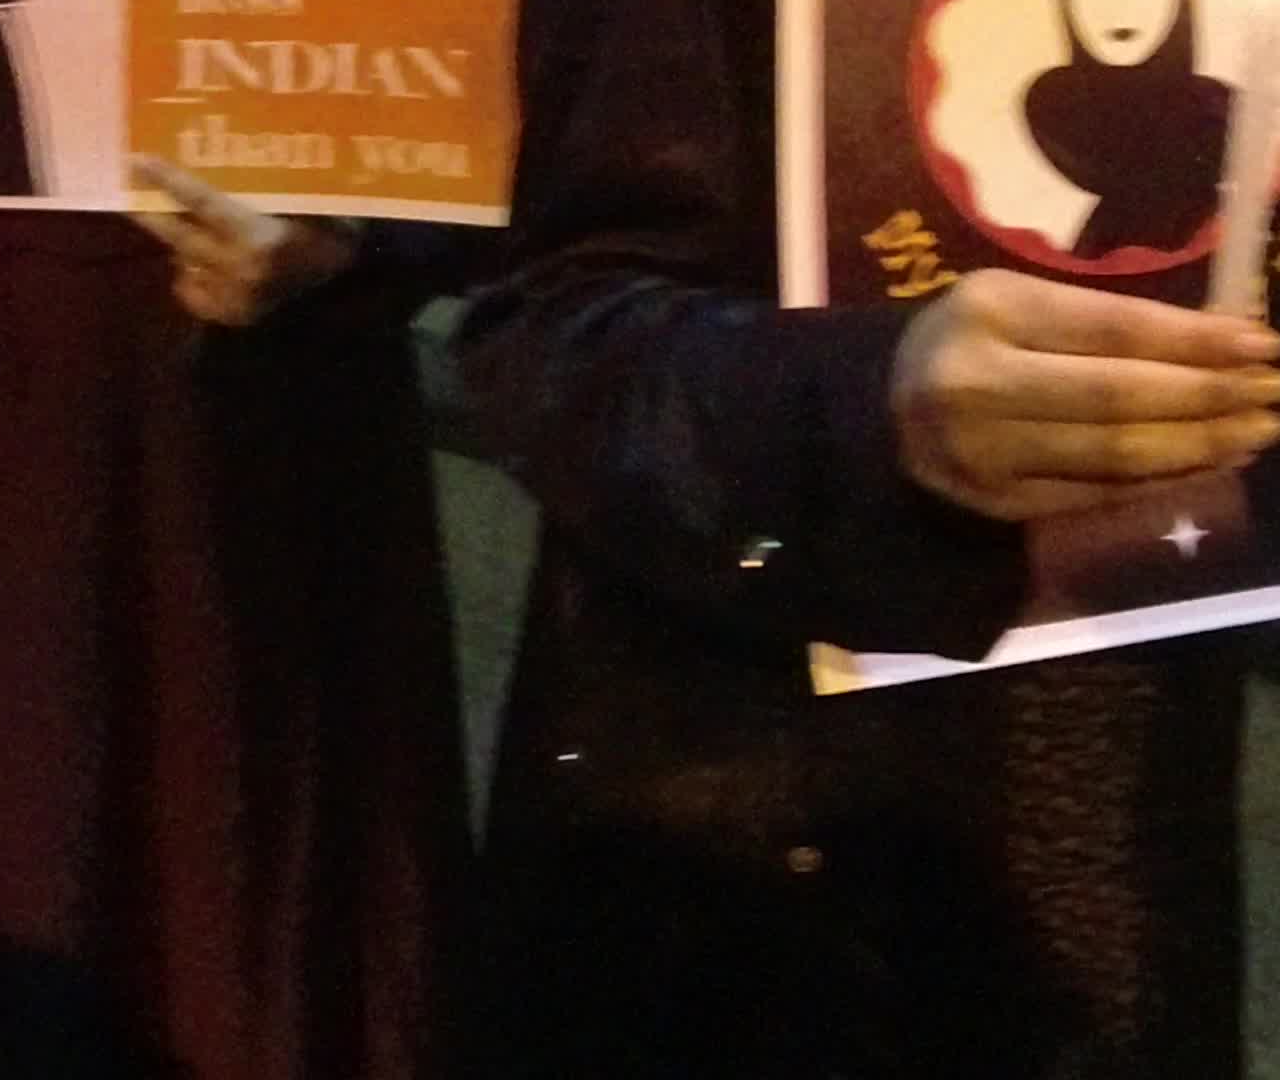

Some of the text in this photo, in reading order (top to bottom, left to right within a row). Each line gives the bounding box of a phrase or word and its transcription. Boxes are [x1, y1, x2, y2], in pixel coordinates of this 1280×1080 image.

[172, 38, 472, 100] INDIAN
[175, 114, 472, 185] than you
